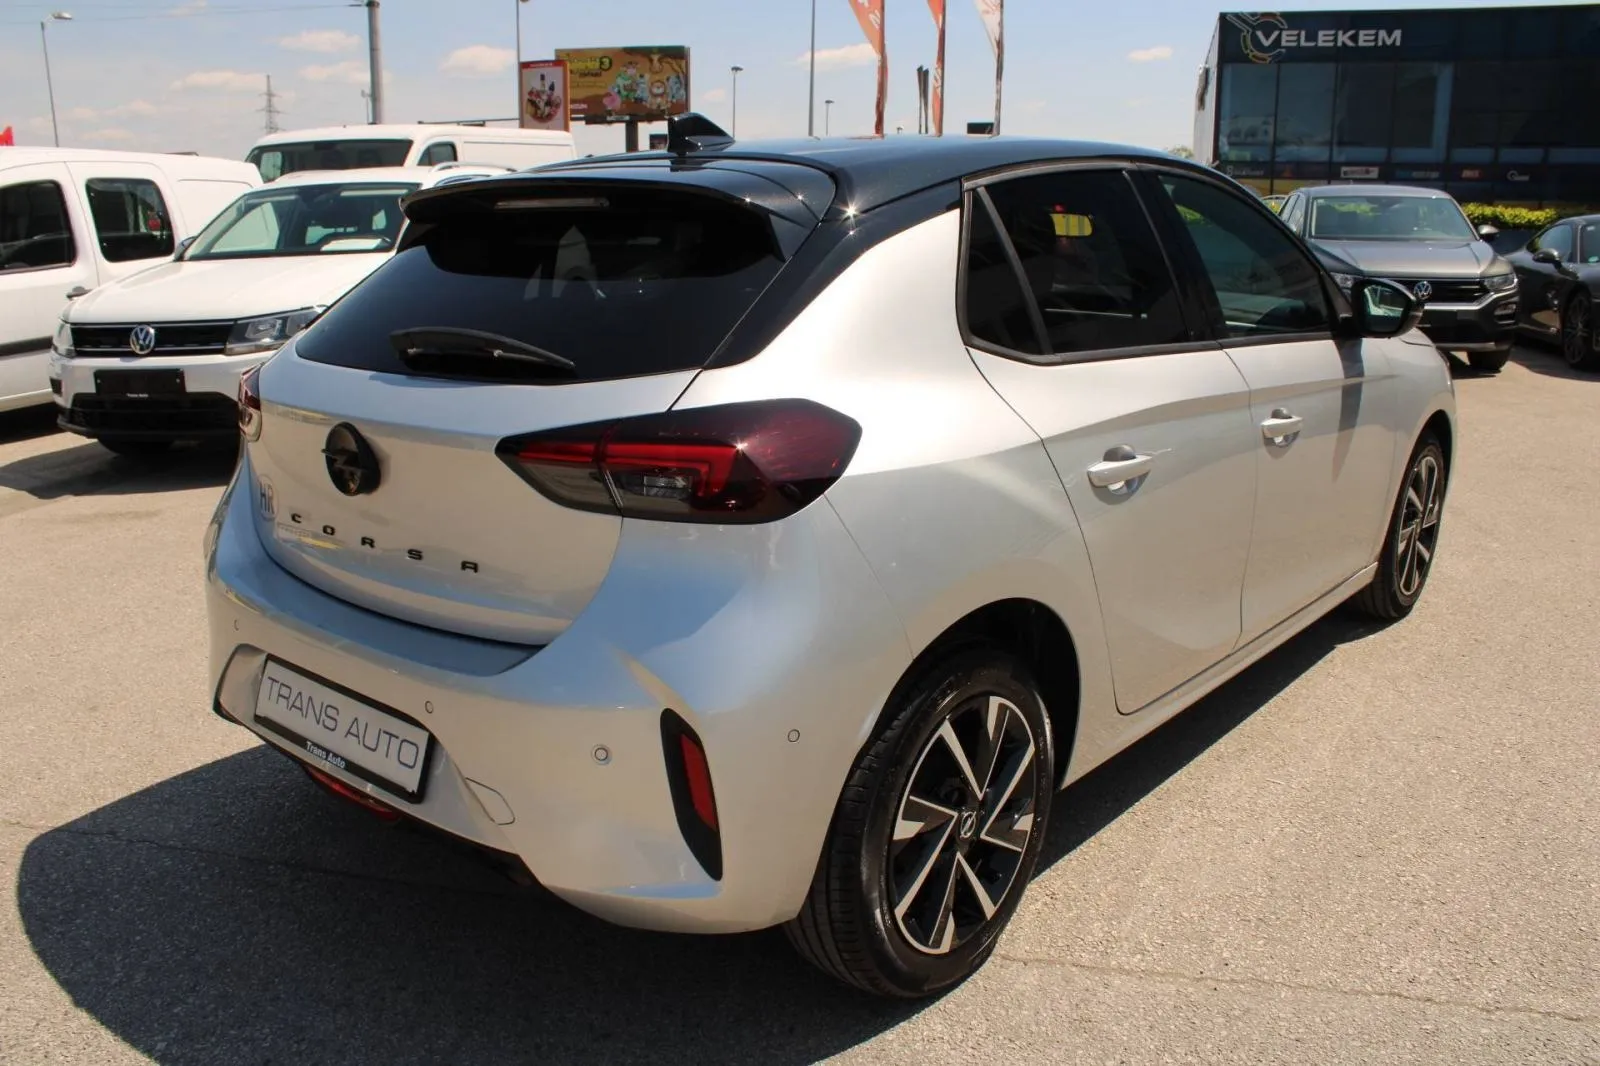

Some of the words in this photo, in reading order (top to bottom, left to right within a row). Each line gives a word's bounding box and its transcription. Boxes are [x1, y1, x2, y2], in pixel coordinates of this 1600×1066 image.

[1255, 29, 1402, 47] VELEKEM
[290, 512, 479, 574] CORSA
[267, 676, 340, 732] TRANS
[344, 717, 419, 769] AUTO
[306, 740, 327, 760] Trans
[327, 752, 346, 769] Auto
